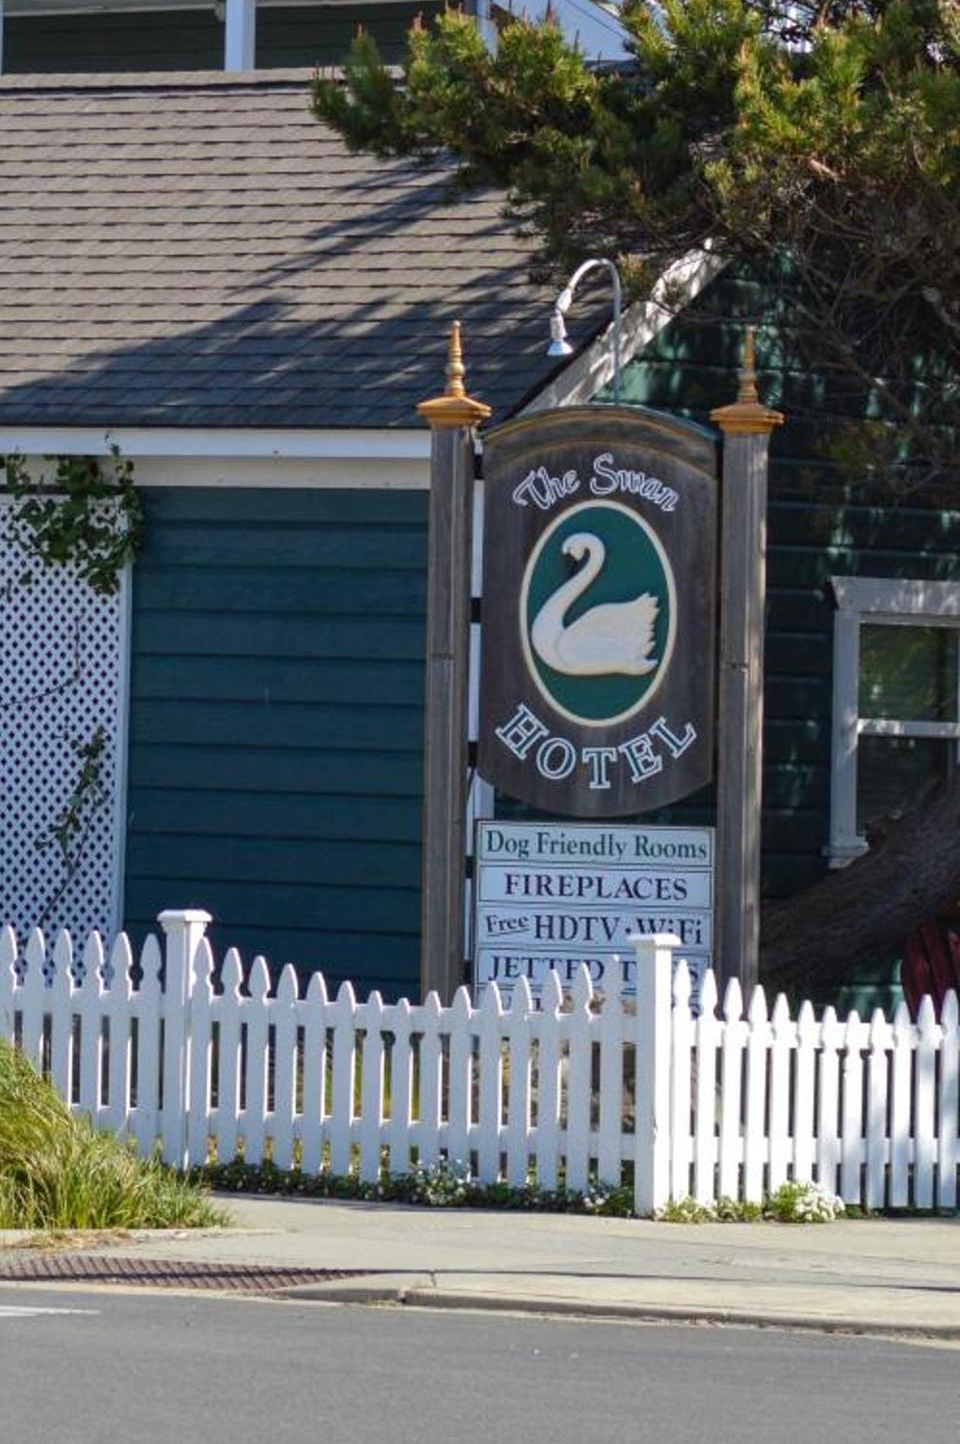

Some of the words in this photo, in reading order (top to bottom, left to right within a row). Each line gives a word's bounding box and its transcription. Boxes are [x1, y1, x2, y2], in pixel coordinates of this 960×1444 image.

[513, 466, 581, 509] The
[589, 452, 680, 512] Swan
[494, 703, 697, 789] HOTEL
[486, 830, 530, 857] Dog
[536, 831, 627, 860] Friendly
[634, 835, 707, 859] Rooms
[505, 873, 688, 901] FIREPLACES
[486, 914, 530, 935] Free
[534, 914, 620, 941] HDTV
